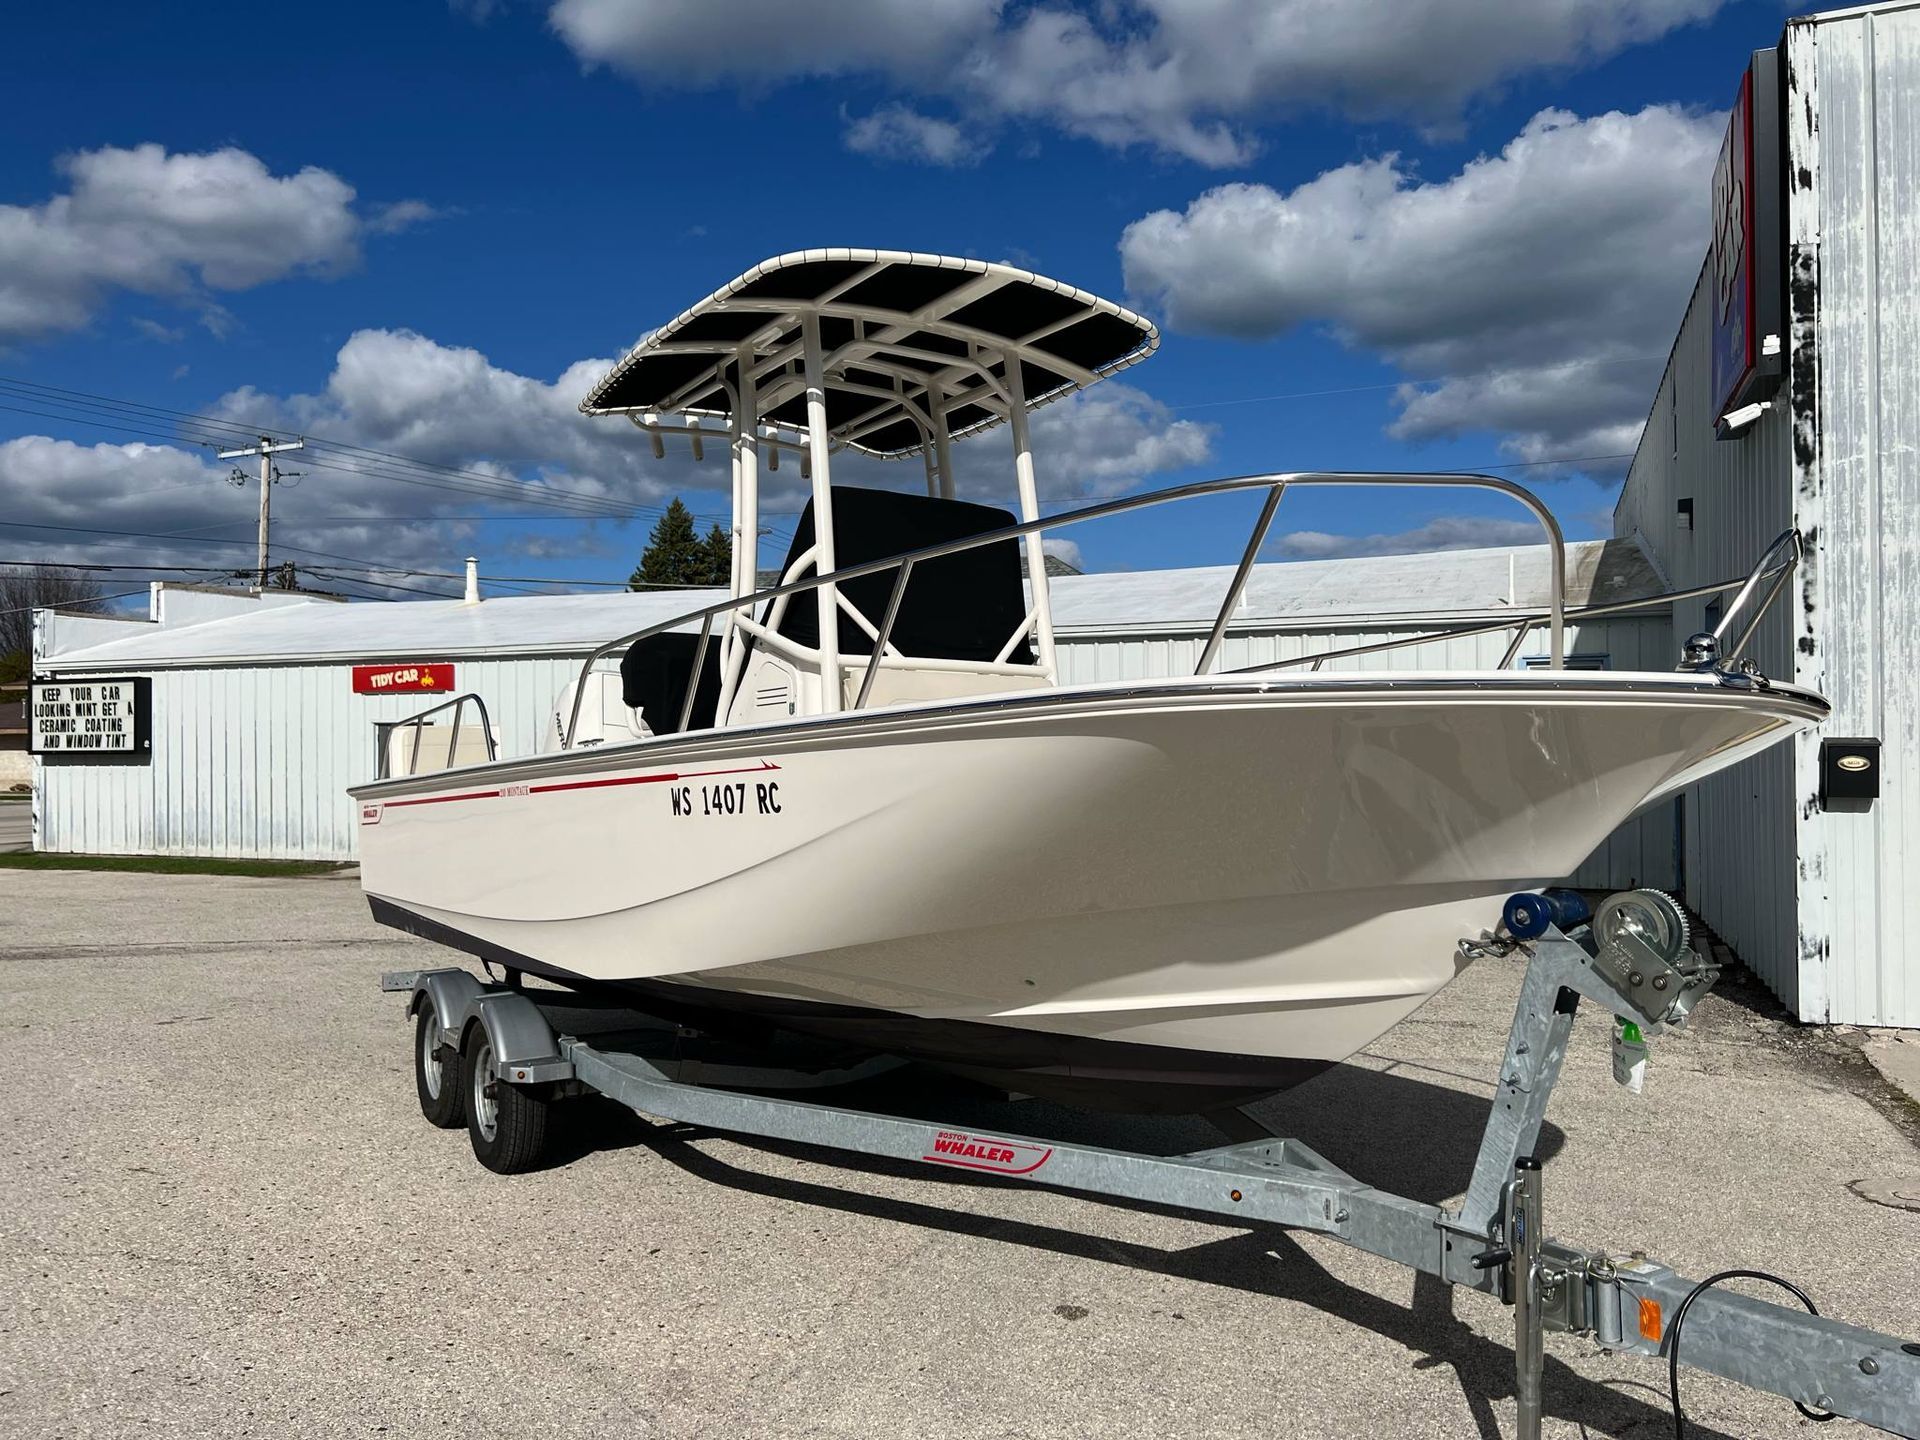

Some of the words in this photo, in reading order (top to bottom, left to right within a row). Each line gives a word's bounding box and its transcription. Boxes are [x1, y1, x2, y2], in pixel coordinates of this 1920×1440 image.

[371, 673, 394, 688] TIDY
[394, 669, 419, 684] CAR
[42, 688, 61, 701] KEEP
[70, 687, 92, 701] YOUR
[101, 686, 120, 700] CAR
[35, 703, 71, 717] LOOKING
[75, 702, 97, 716] MINT
[102, 702, 118, 716] GET
[127, 701, 134, 715] A
[40, 719, 76, 733] CERAMIC
[85, 718, 122, 732] COATING
[43, 734, 60, 748] AND
[66, 734, 102, 748] WINDOW
[106, 734, 127, 748] TINT
[671, 787, 692, 816] WS
[702, 783, 745, 815] 1407
[756, 782, 781, 814] RC
[938, 1132, 968, 1142] BOSTON
[934, 1139, 1015, 1163] WHALER
